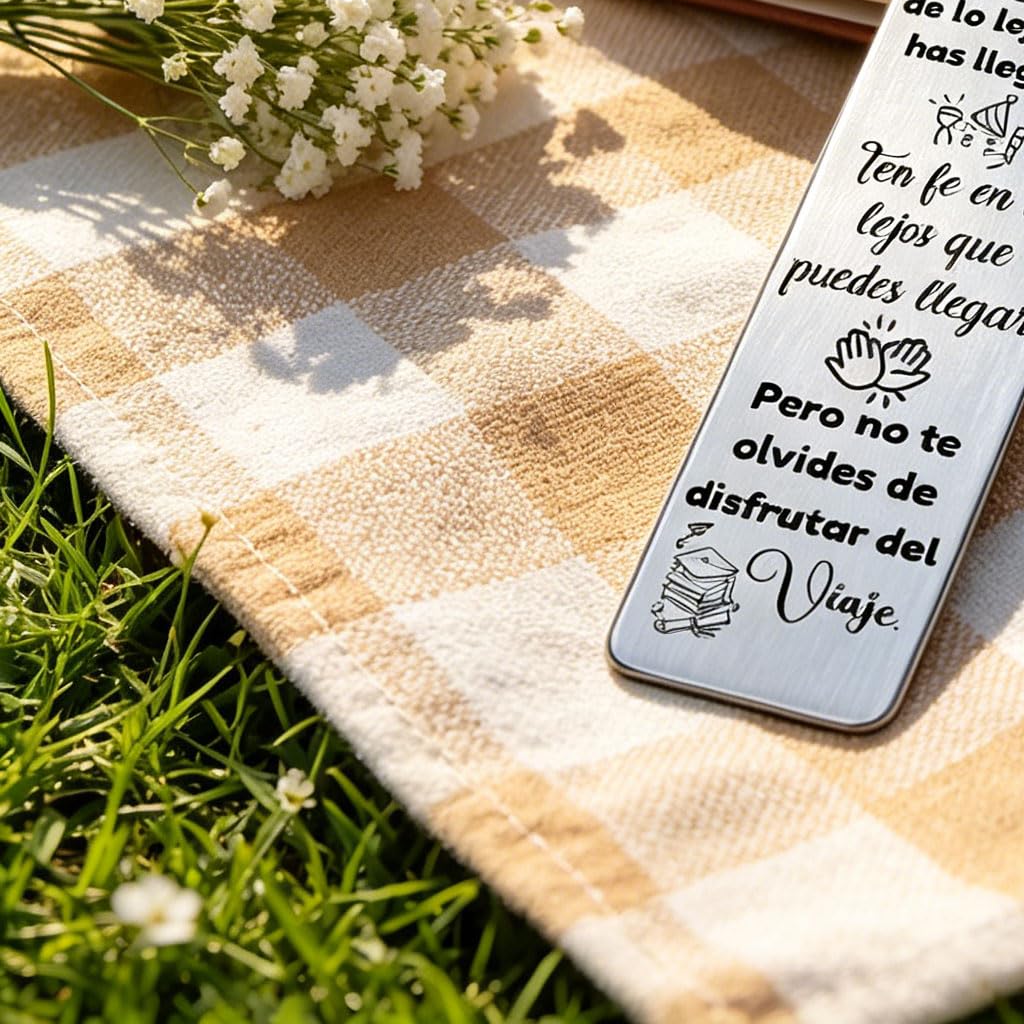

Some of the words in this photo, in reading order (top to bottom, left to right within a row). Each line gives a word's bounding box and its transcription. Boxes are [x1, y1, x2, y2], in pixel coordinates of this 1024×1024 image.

[952, 0, 985, 26] lo
[904, 33, 965, 66] has
[857, 141, 915, 187] Ten
[920, 163, 961, 206] fe
[970, 184, 1014, 211] en
[856, 202, 938, 255] lejos
[944, 233, 1014, 270] que
[778, 257, 906, 304] puedes
[750, 382, 844, 428] Pero
[855, 415, 908, 444] no
[920, 426, 961, 457] te
[733, 434, 876, 491] olvides
[887, 472, 937, 506] de
[686, 480, 869, 546] disfrutar
[876, 527, 940, 566] del
[746, 549, 899, 634] Viaje.
